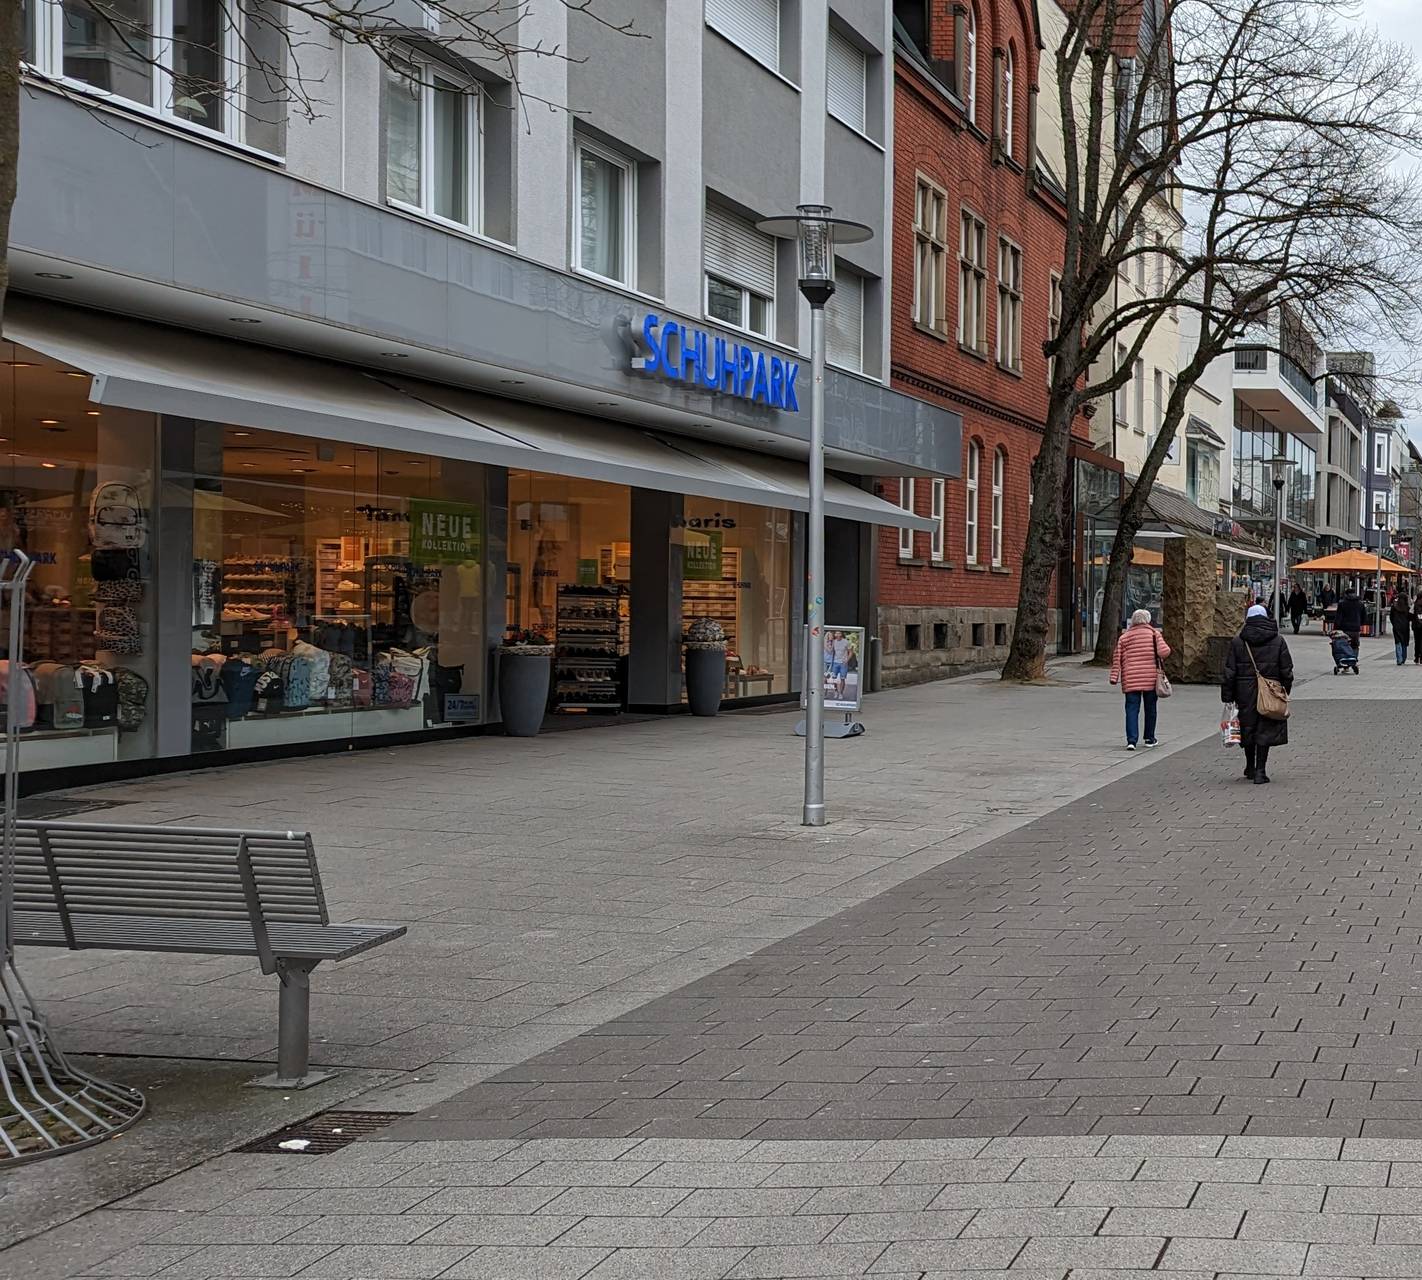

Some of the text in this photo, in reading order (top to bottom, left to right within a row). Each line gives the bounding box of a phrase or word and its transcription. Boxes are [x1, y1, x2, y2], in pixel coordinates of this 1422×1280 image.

[643, 314, 799, 412] SCHUHPARK
[422, 512, 472, 539] NEUE
[422, 539, 472, 553] KOLLEKTION
